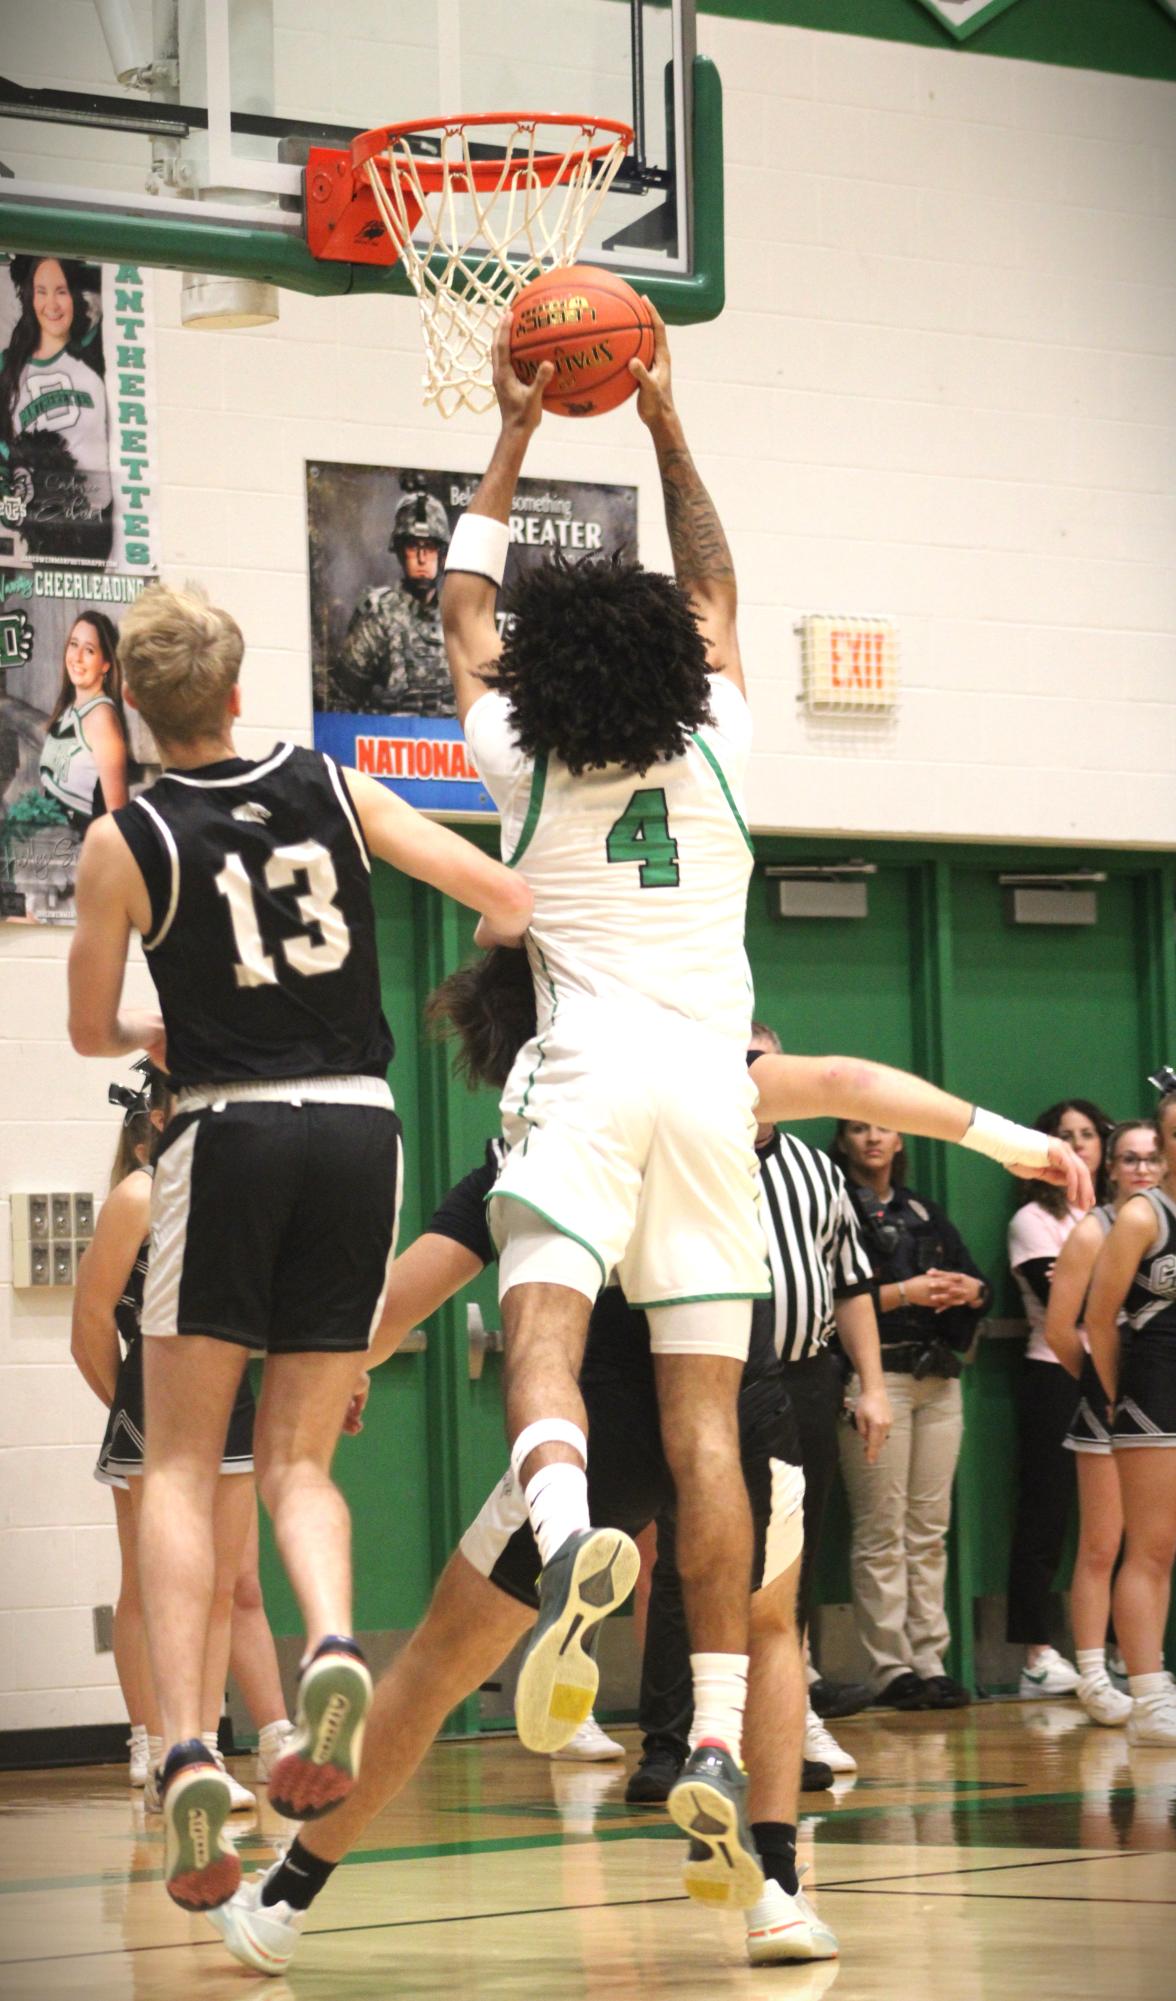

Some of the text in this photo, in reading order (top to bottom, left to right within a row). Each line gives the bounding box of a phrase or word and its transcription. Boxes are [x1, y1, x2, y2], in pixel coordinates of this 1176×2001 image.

[512, 339, 614, 382] SPALNG
[512, 491, 573, 520] something
[508, 516, 602, 550] REATER
[830, 630, 884, 690] EXIT
[605, 787, 680, 889] 4
[214, 838, 351, 988] 13
